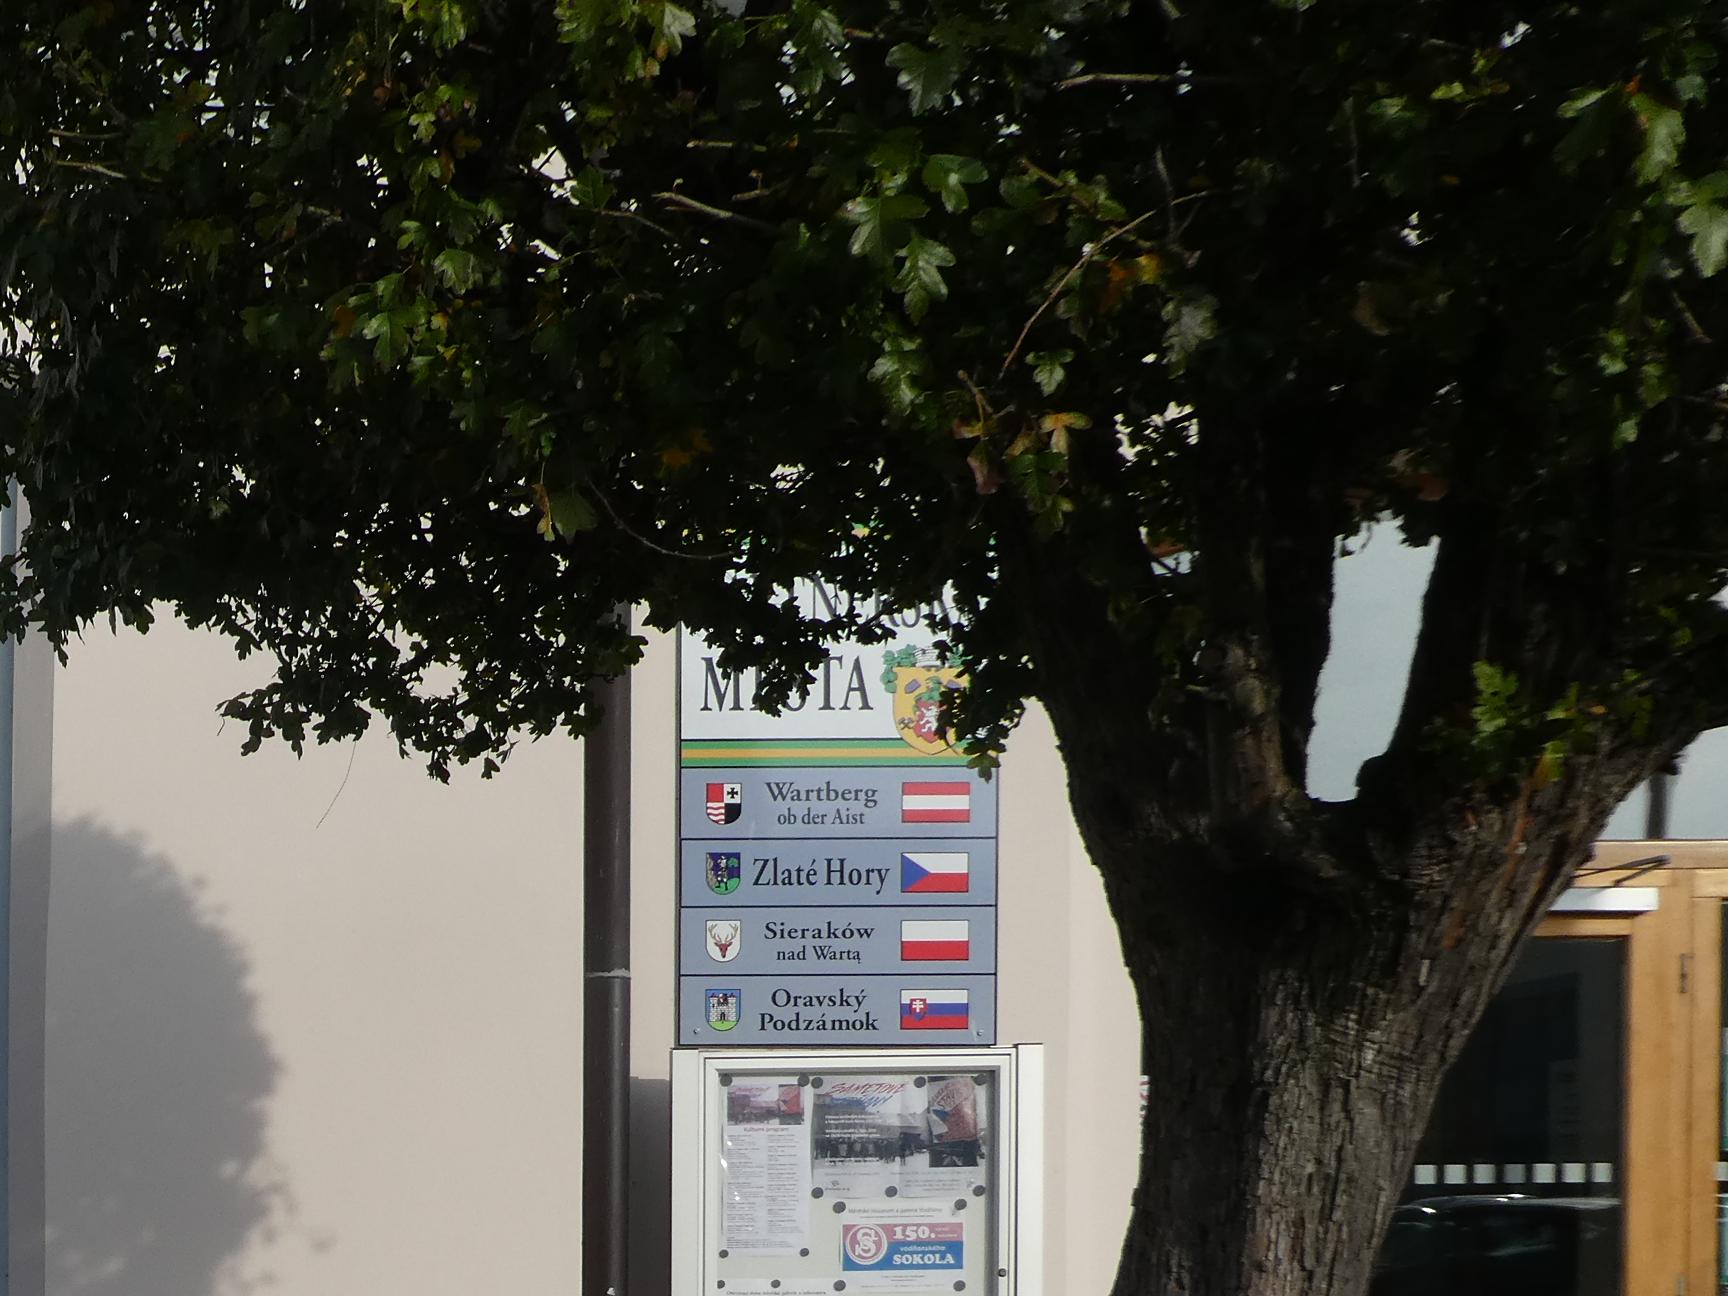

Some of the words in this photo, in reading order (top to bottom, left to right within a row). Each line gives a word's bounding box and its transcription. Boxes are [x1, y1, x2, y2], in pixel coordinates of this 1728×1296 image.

[700, 655, 874, 712] MTA
[764, 781, 879, 809] Wartberg
[777, 807, 797, 826] ob
[801, 807, 828, 826] der
[831, 807, 865, 826] Aist
[752, 857, 818, 887] Zlaté
[824, 858, 890, 896] Hory
[764, 921, 876, 940] Sieraków
[776, 945, 807, 961] nad
[812, 945, 861, 964] Wartą
[770, 988, 868, 1013] Oravský
[758, 1012, 879, 1031] Podzámok
[892, 1226, 936, 1241] 150.
[892, 1253, 956, 1265] SOKOLA
